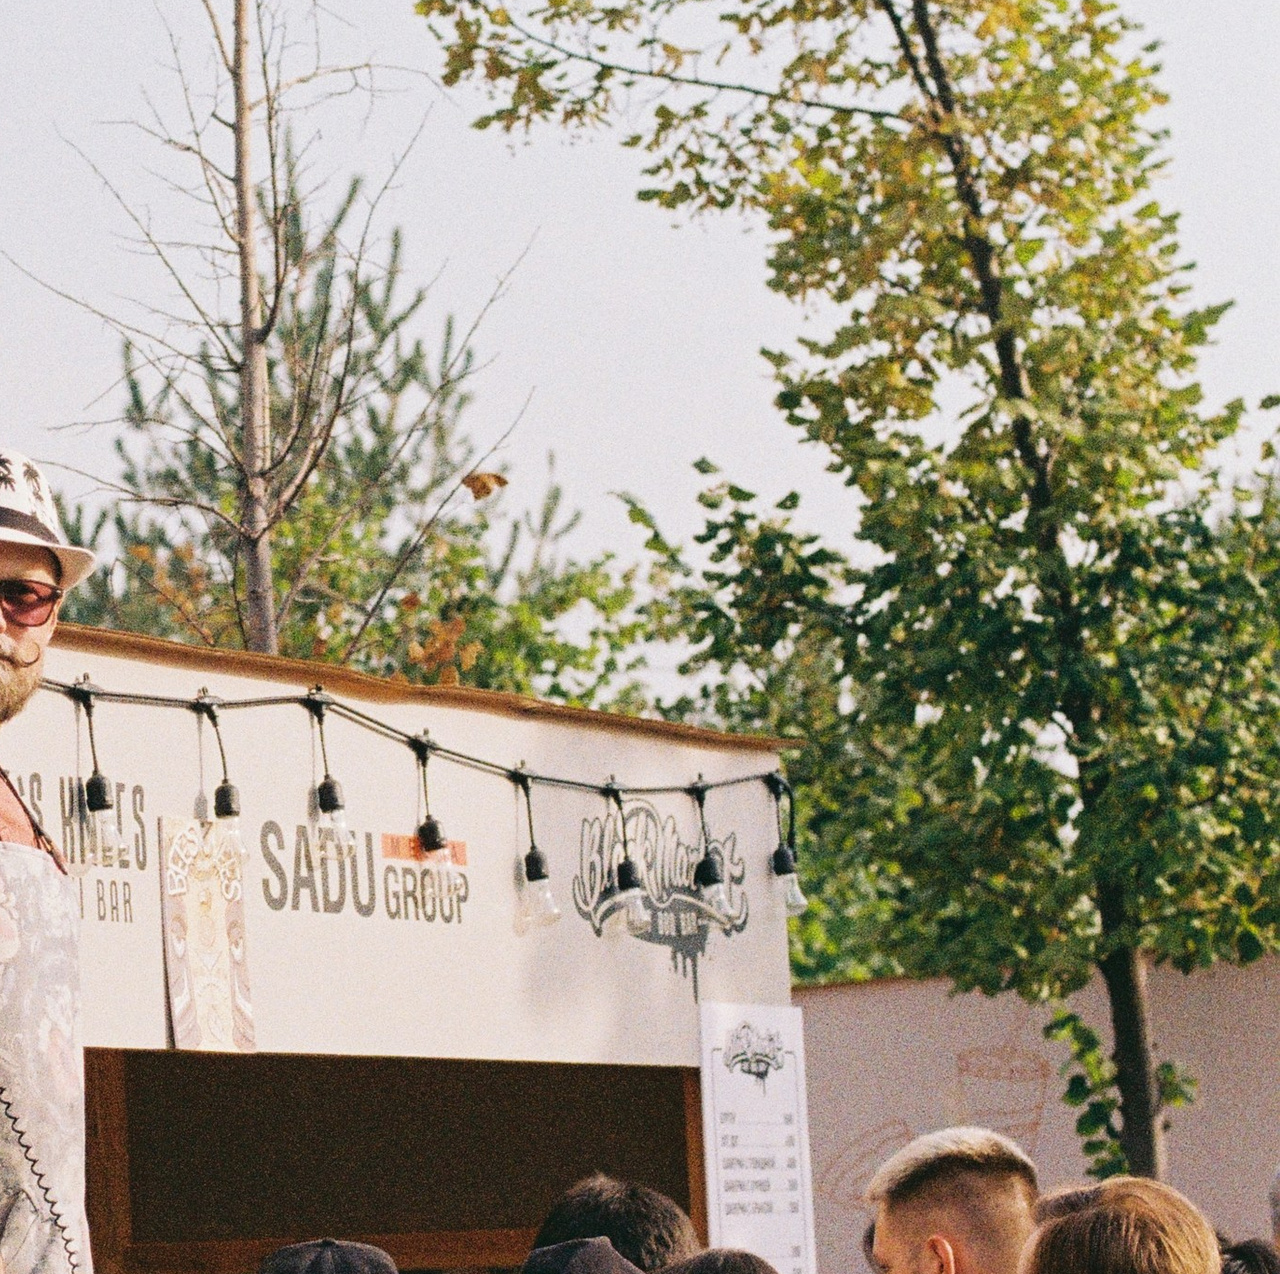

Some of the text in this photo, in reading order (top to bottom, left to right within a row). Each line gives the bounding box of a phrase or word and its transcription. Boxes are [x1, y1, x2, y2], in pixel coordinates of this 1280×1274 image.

[260, 820, 376, 917] SADU
[384, 865, 469, 924] GROUP
[96, 878, 133, 923] BAR
